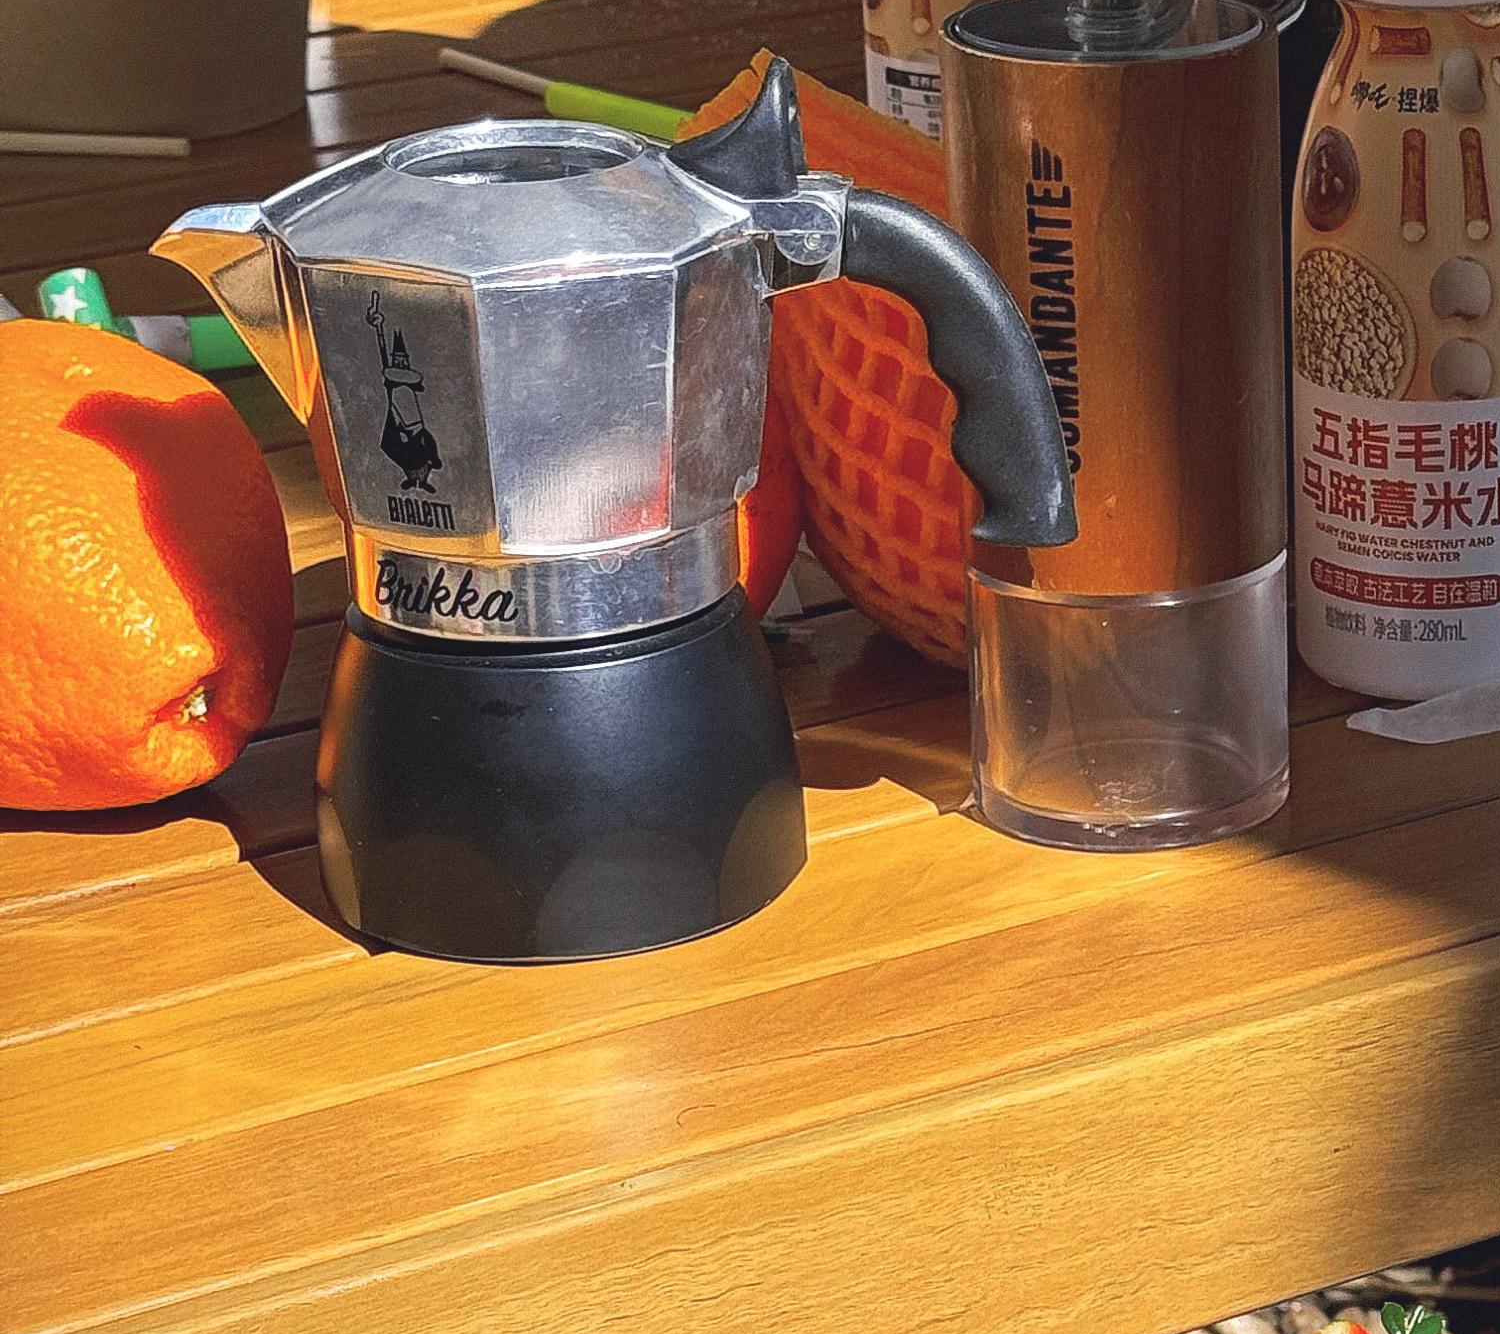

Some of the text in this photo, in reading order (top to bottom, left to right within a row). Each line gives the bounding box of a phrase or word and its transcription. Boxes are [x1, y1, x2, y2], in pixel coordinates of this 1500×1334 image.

[1026, 181, 1082, 474] MANDANTE
[1312, 407, 1499, 473] 五指毛桃
[1358, 533, 1399, 549] WATER
[1400, 538, 1466, 550] CHESTNUT
[1468, 536, 1496, 548] AND
[1416, 551, 1461, 563] WATER
[375, 559, 519, 622] Brikka
[1363, 577, 1427, 605] 古法工艺
